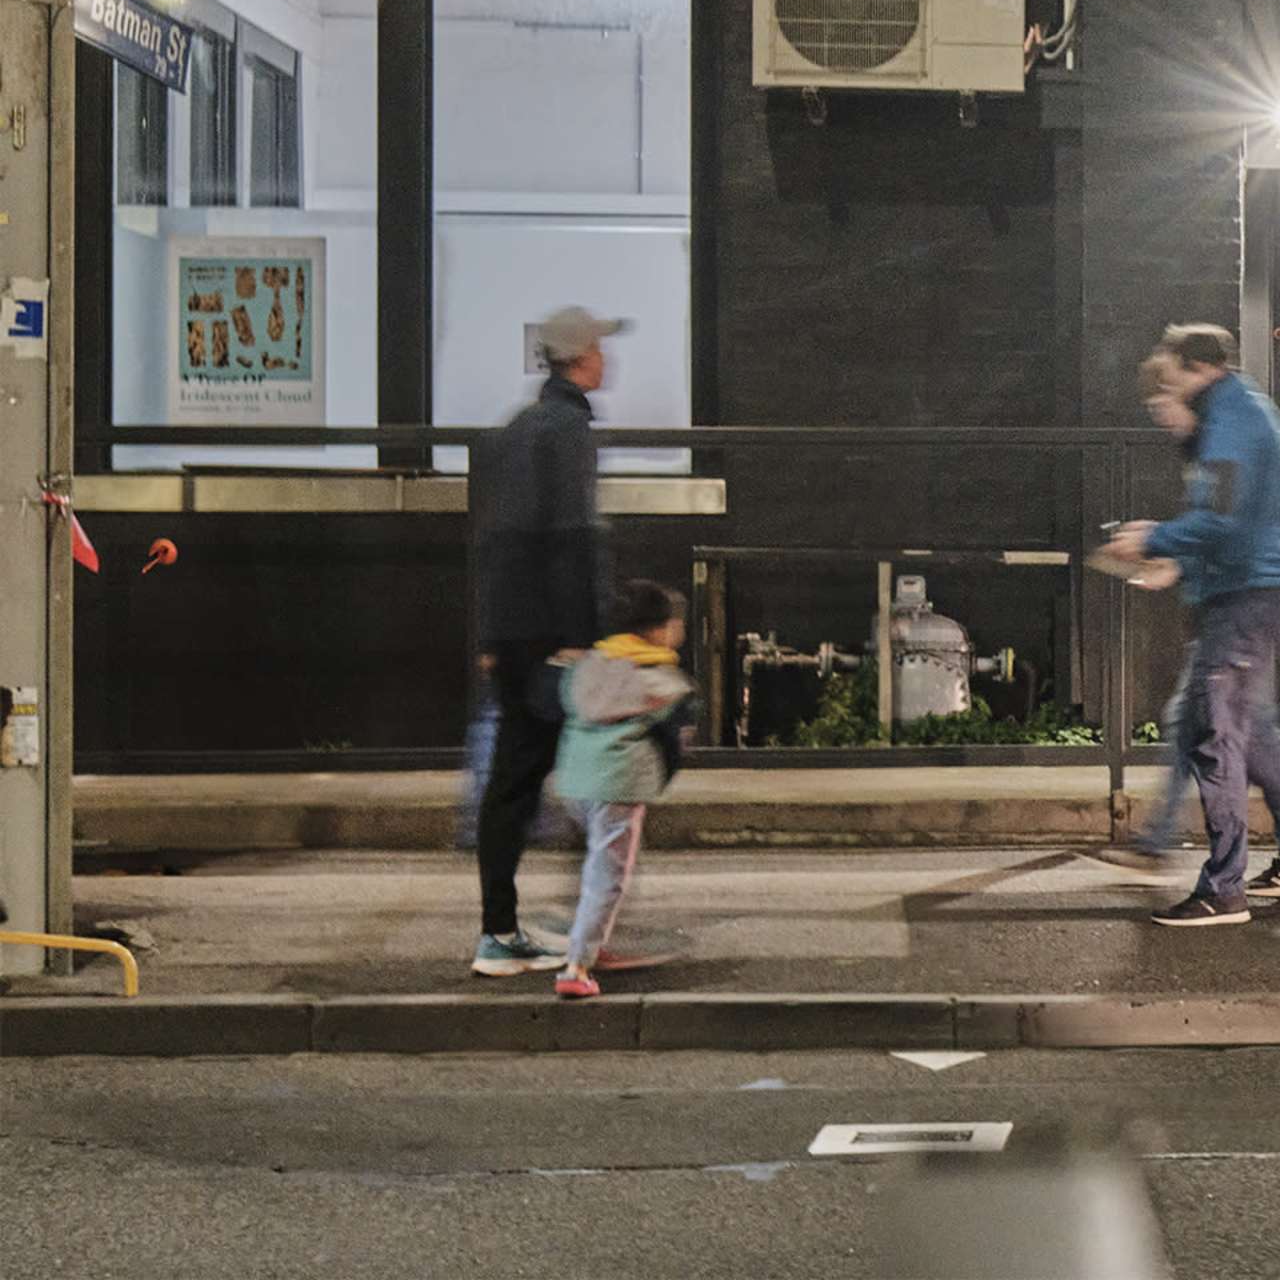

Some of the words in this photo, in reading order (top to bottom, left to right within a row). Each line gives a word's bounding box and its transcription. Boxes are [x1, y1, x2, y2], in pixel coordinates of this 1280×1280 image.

[167, 25, 186, 65] St
[194, 373, 241, 385] Trace
[179, 388, 260, 402] Iridescent
[264, 388, 312, 403] Cloud
